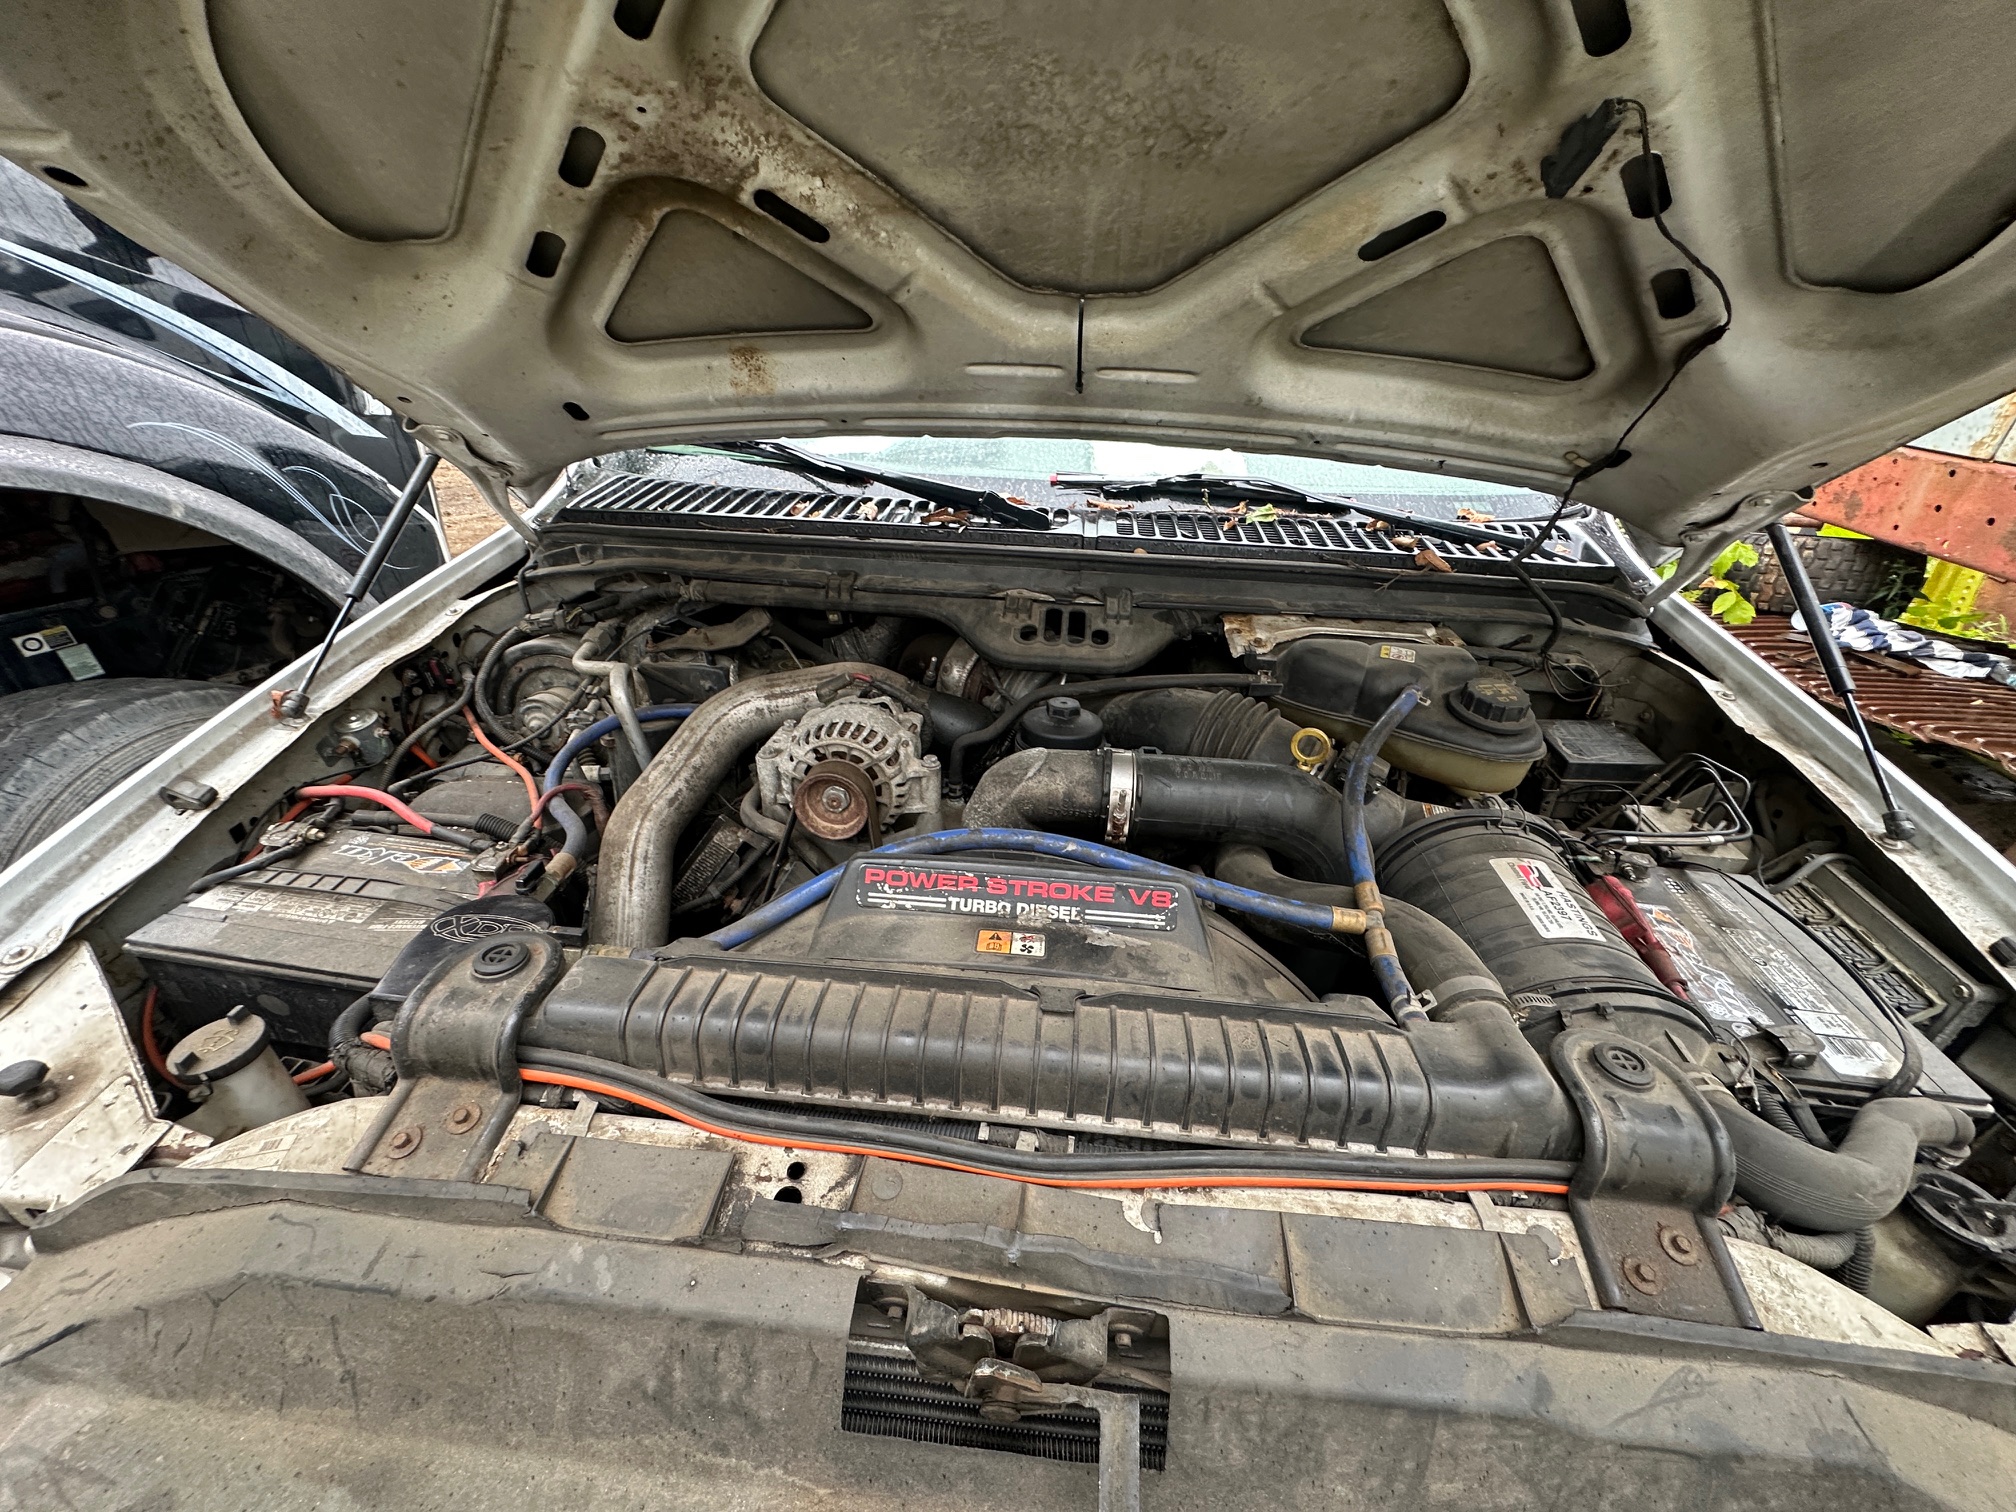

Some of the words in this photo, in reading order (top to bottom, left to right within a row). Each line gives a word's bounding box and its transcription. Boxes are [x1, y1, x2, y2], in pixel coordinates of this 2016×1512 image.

[864, 867, 978, 893] POWER
[986, 876, 1115, 903] STROKE
[1128, 887, 1172, 909] V8
[1543, 890, 1572, 921] AF2397
[948, 896, 1011, 916] TURBO
[1016, 902, 1081, 921] DIESEL
[1556, 890, 1598, 937] HASTINGS
